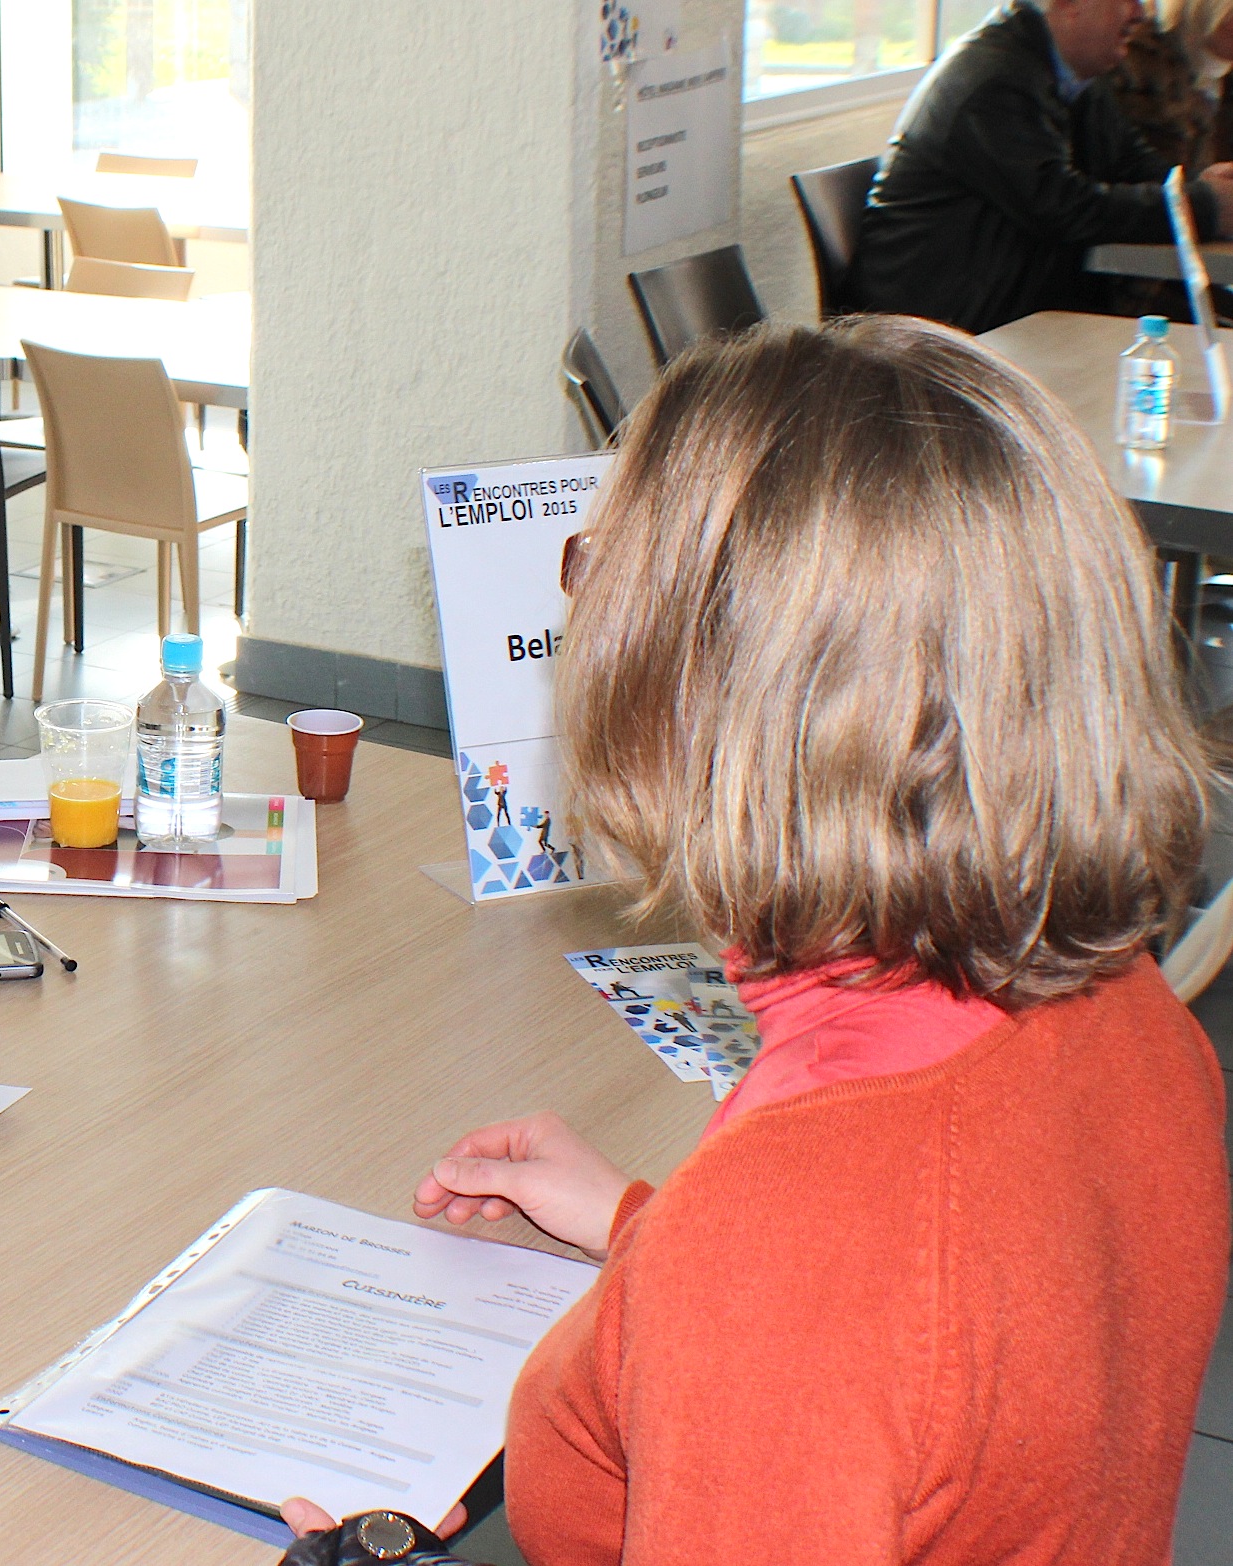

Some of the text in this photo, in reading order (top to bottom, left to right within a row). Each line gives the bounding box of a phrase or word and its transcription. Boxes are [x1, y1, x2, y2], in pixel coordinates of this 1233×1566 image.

[433, 483, 451, 495] LES
[561, 476, 599, 493] POUR
[438, 499, 578, 528] L'EMPLOI 2015
[616, 960, 697, 974] L'EMPLOI
[342, 1279, 447, 1310] CUISINIÈRE
